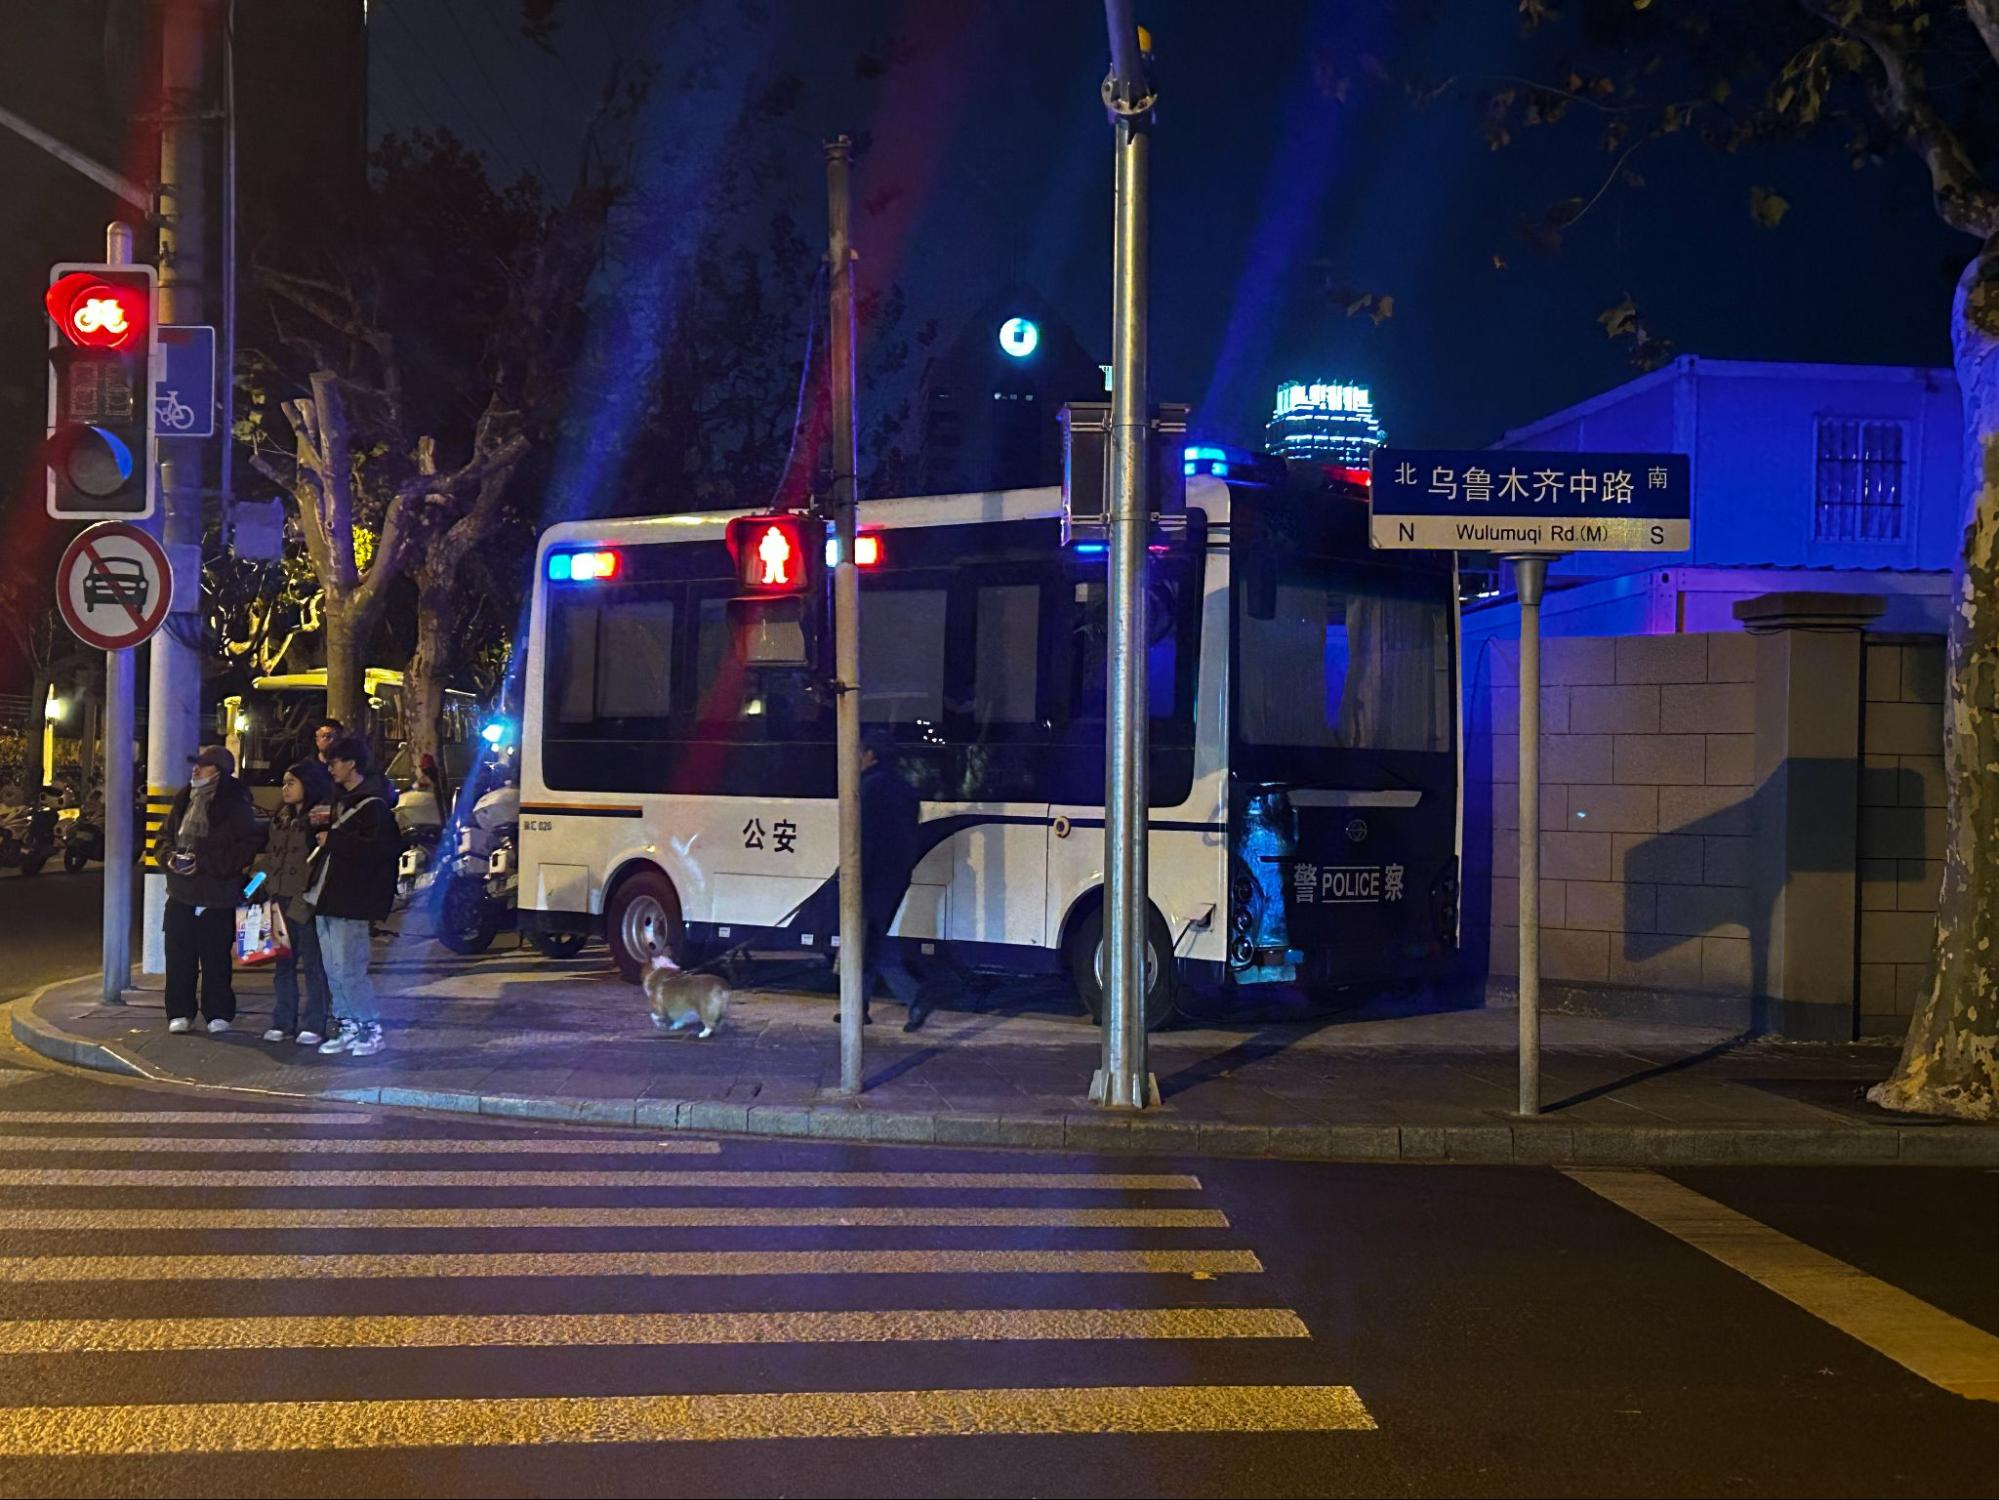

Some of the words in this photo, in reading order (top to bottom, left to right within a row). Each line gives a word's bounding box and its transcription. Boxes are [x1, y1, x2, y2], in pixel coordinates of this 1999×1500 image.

[1395, 463, 1417, 485] 北
[1428, 465, 1634, 503] 乌鲁木齐中路
[1648, 466, 1668, 489] 南
[1400, 523, 1415, 542] N
[1456, 524, 1542, 545] Wulumuqi
[1650, 526, 1664, 545] S
[743, 818, 797, 853] 公安
[1294, 863, 1317, 903] 警
[1322, 872, 1380, 896] POLICE
[1385, 863, 1404, 901] 察
